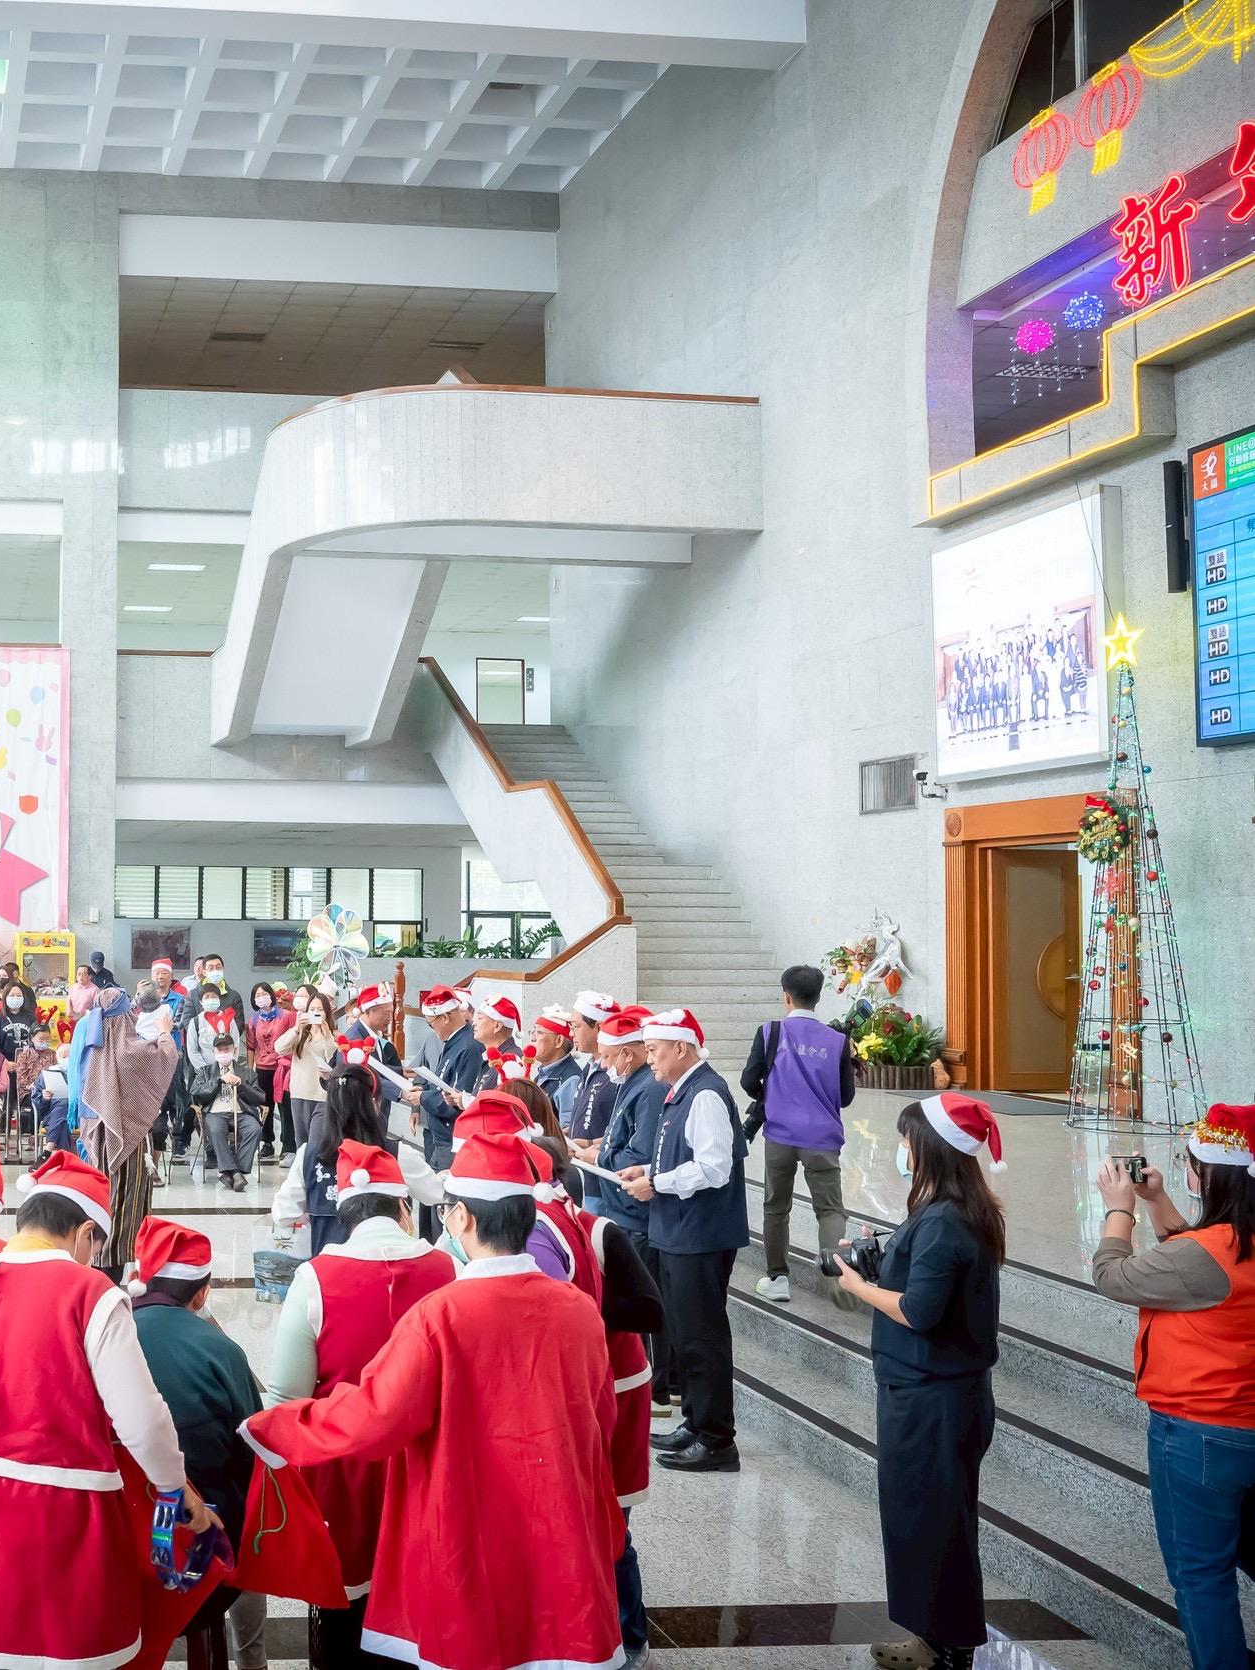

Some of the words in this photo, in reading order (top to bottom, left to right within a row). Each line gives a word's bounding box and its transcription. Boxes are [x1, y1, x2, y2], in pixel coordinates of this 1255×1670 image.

[1207, 567, 1226, 583] HD
[1208, 597, 1227, 613] HD
[1208, 641, 1228, 656] HD
[1210, 669, 1230, 685] HD
[1211, 708, 1231, 724] HD
